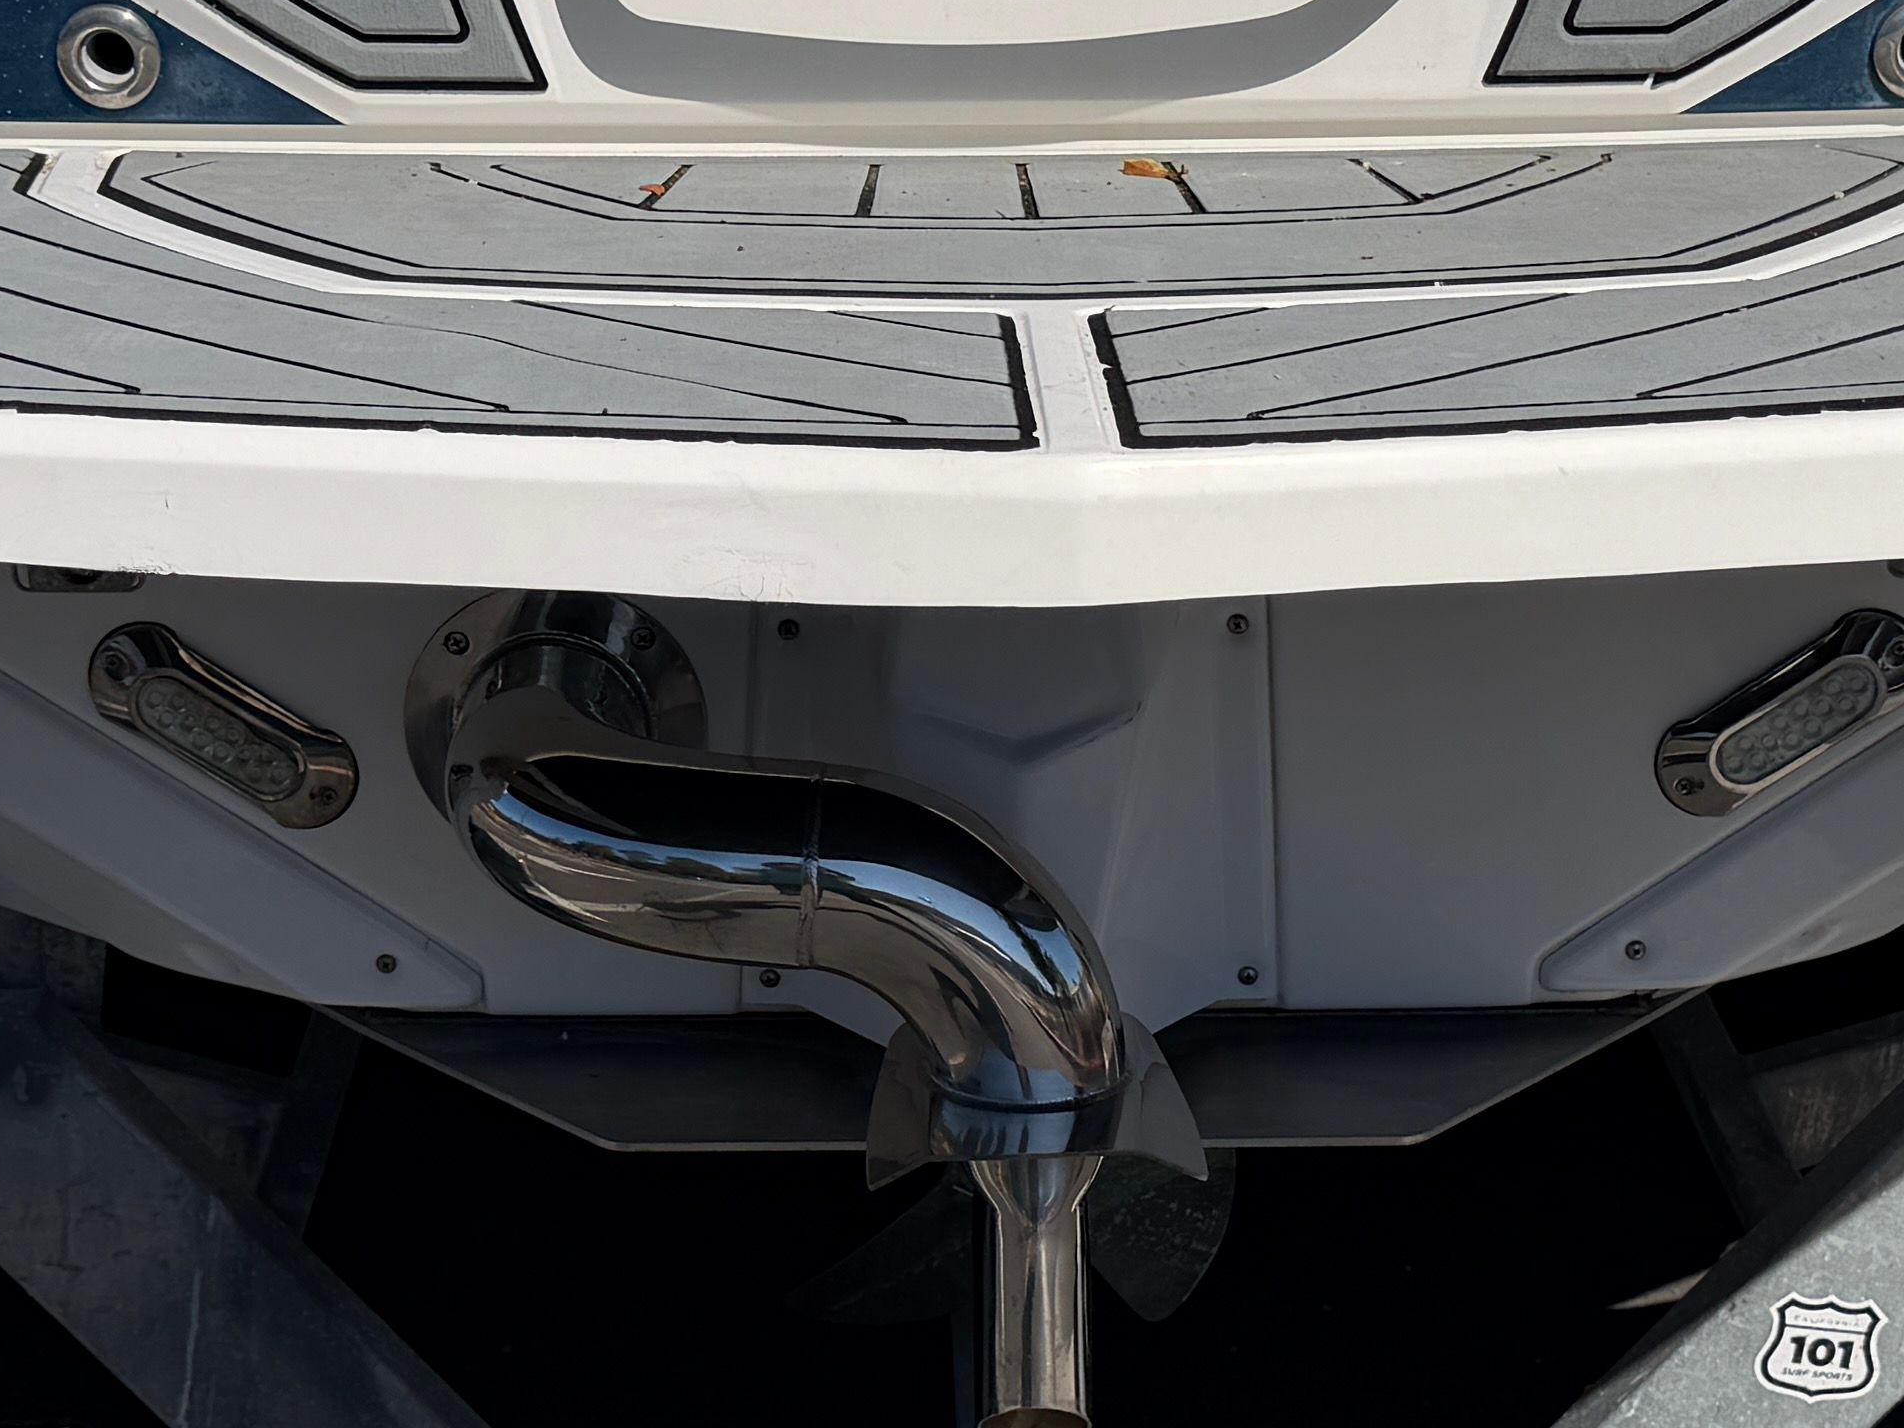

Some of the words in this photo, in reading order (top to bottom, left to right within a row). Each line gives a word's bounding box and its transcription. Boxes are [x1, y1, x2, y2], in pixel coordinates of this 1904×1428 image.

[1790, 1336, 1854, 1369] 101
[1781, 1367, 1810, 1377] SURF
[1811, 1370, 1854, 1382] SPORTS
